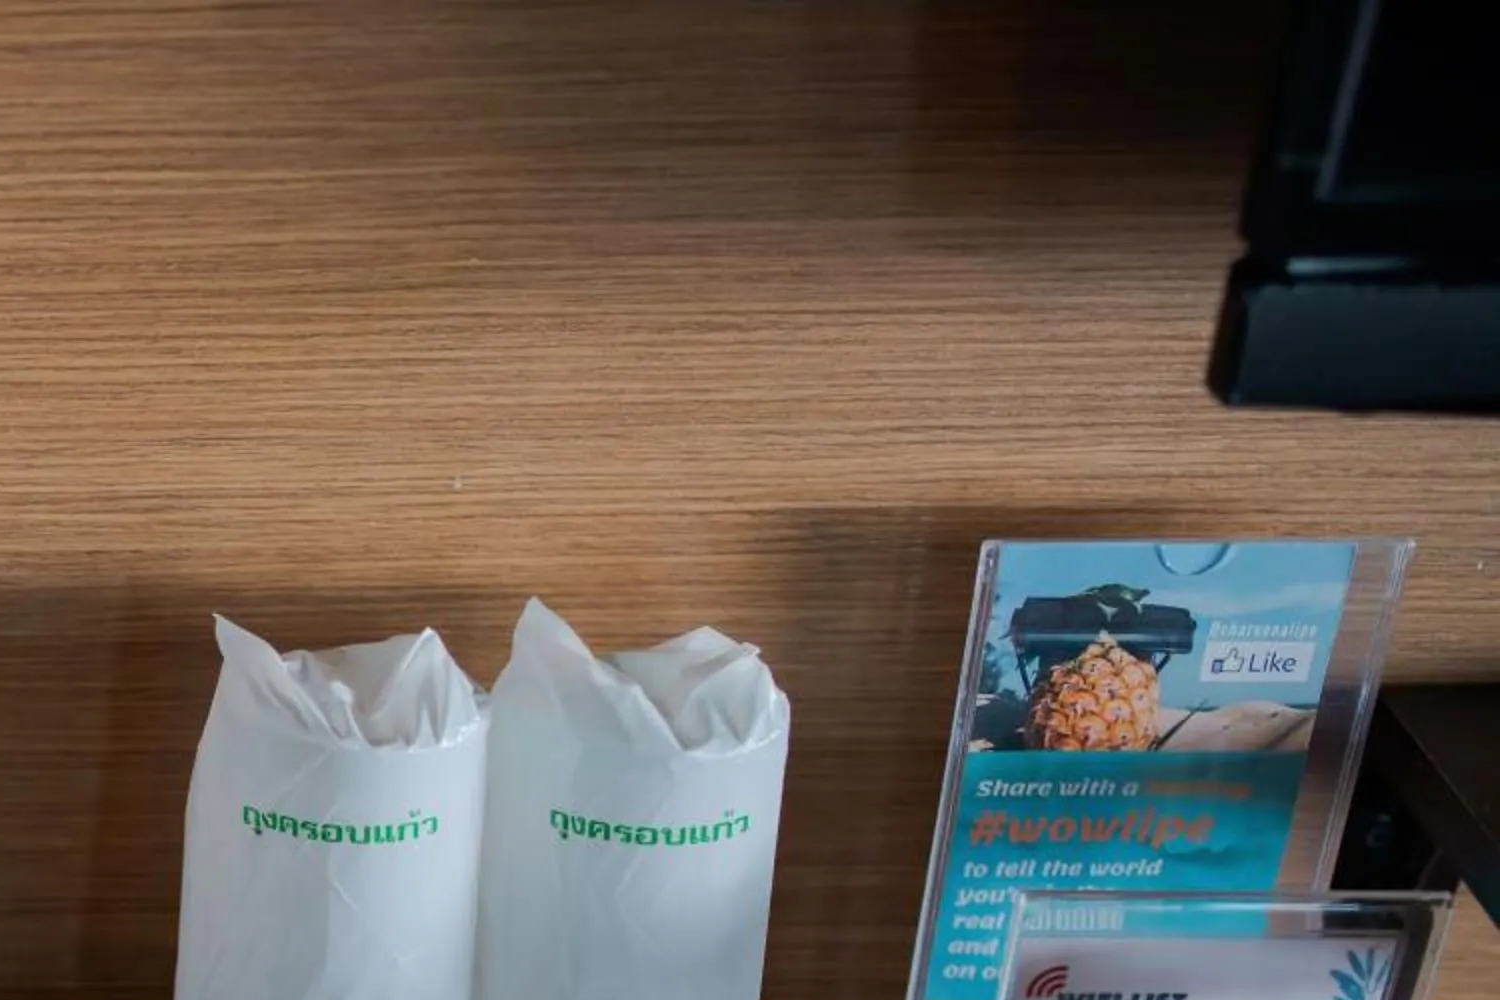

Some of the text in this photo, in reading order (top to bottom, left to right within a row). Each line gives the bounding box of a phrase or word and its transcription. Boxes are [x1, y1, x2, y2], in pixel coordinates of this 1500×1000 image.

[1248, 650, 1297, 673] Like
[976, 778, 1051, 797] Share
[1059, 777, 1114, 797] with
[1120, 780, 1140, 797] a
[963, 858, 1164, 877] to tell the world
[952, 911, 1005, 930] real
[948, 938, 999, 956] and
[943, 964, 976, 980] on
